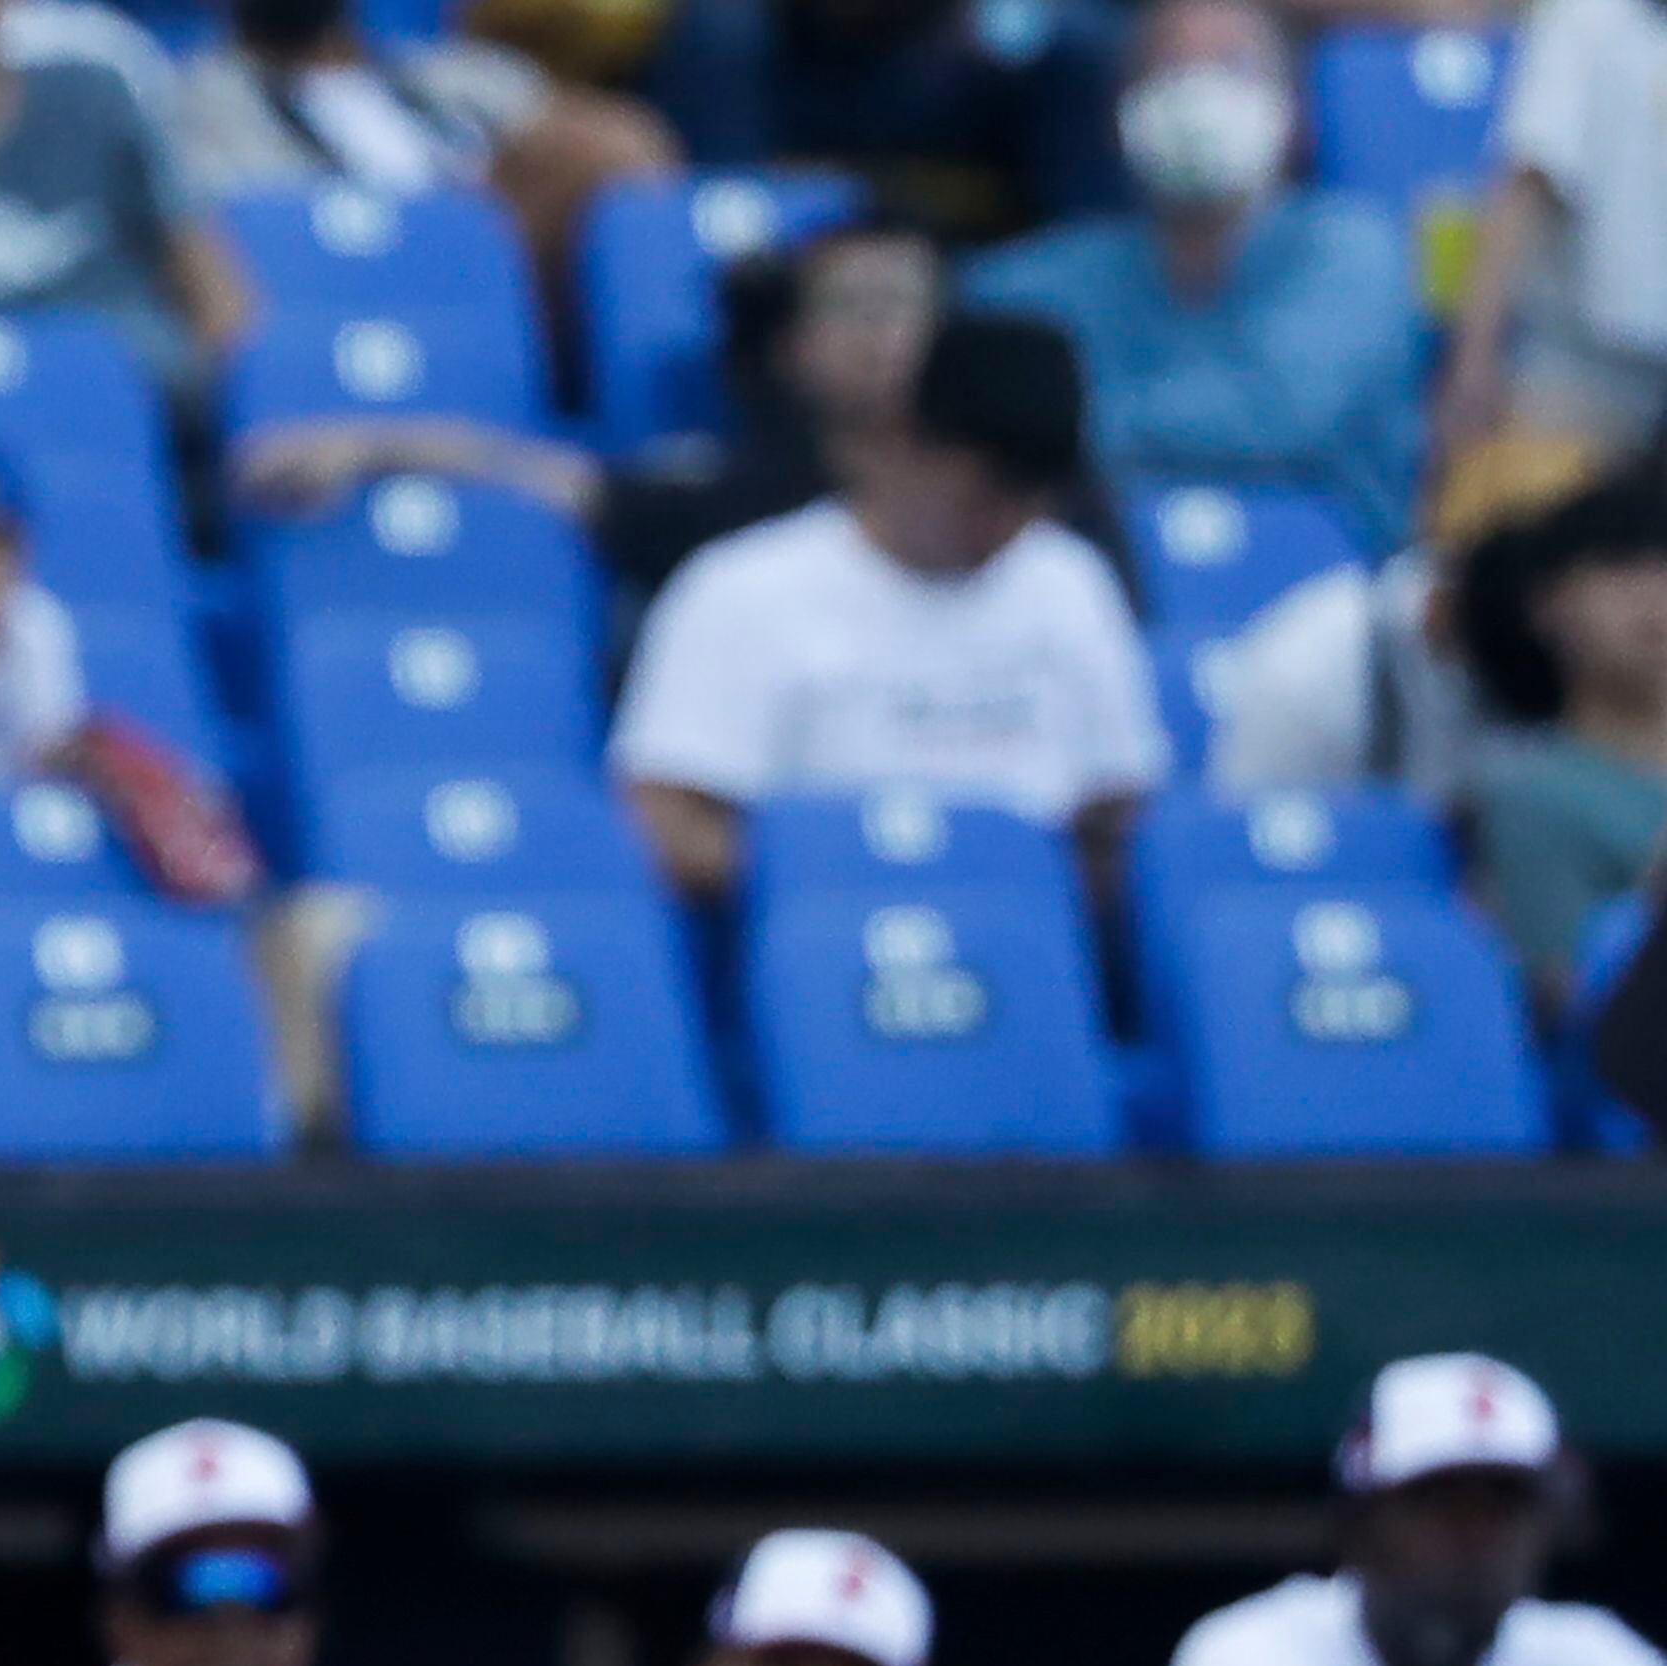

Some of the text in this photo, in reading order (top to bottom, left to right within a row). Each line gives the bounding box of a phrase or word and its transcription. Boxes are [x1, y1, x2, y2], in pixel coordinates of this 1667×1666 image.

[69, 1285, 353, 1381] WORLD
[365, 1285, 754, 1380] BASEBALL
[769, 1284, 1110, 1378] CLASSIC
